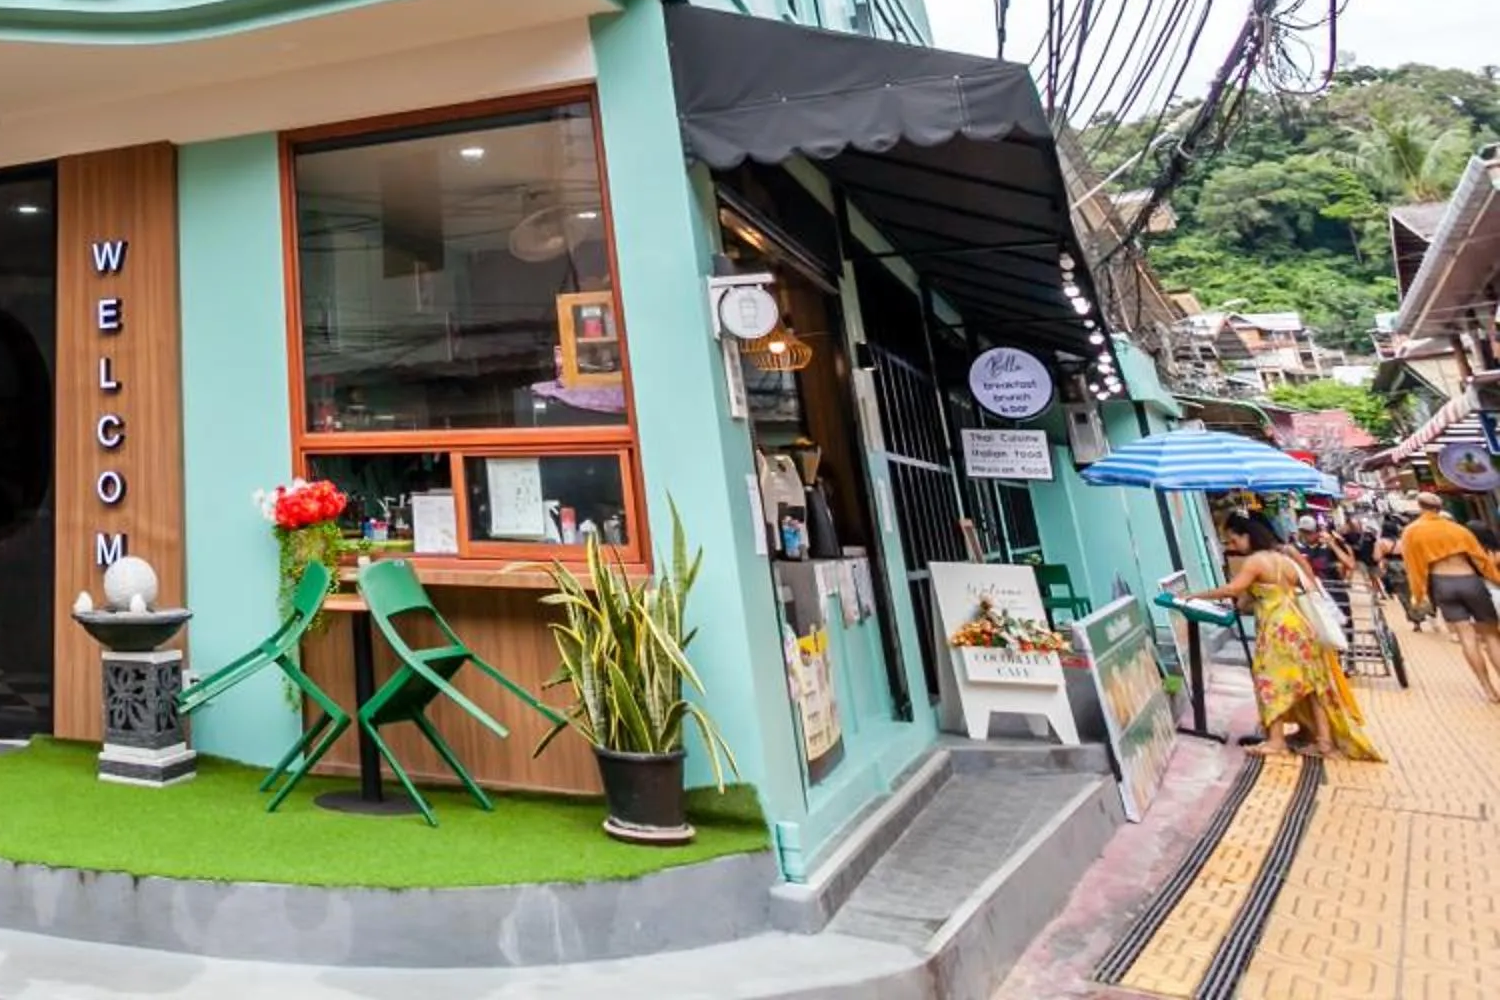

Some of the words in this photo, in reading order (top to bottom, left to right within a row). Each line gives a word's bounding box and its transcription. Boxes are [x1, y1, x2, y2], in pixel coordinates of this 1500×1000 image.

[992, 392, 1031, 402] brunch
[92, 241, 127, 565] WELCOM
[970, 432, 994, 442] Thai
[1000, 433, 1039, 443] Cuisine
[1014, 449, 1044, 459] food
[1021, 465, 1049, 475] food
